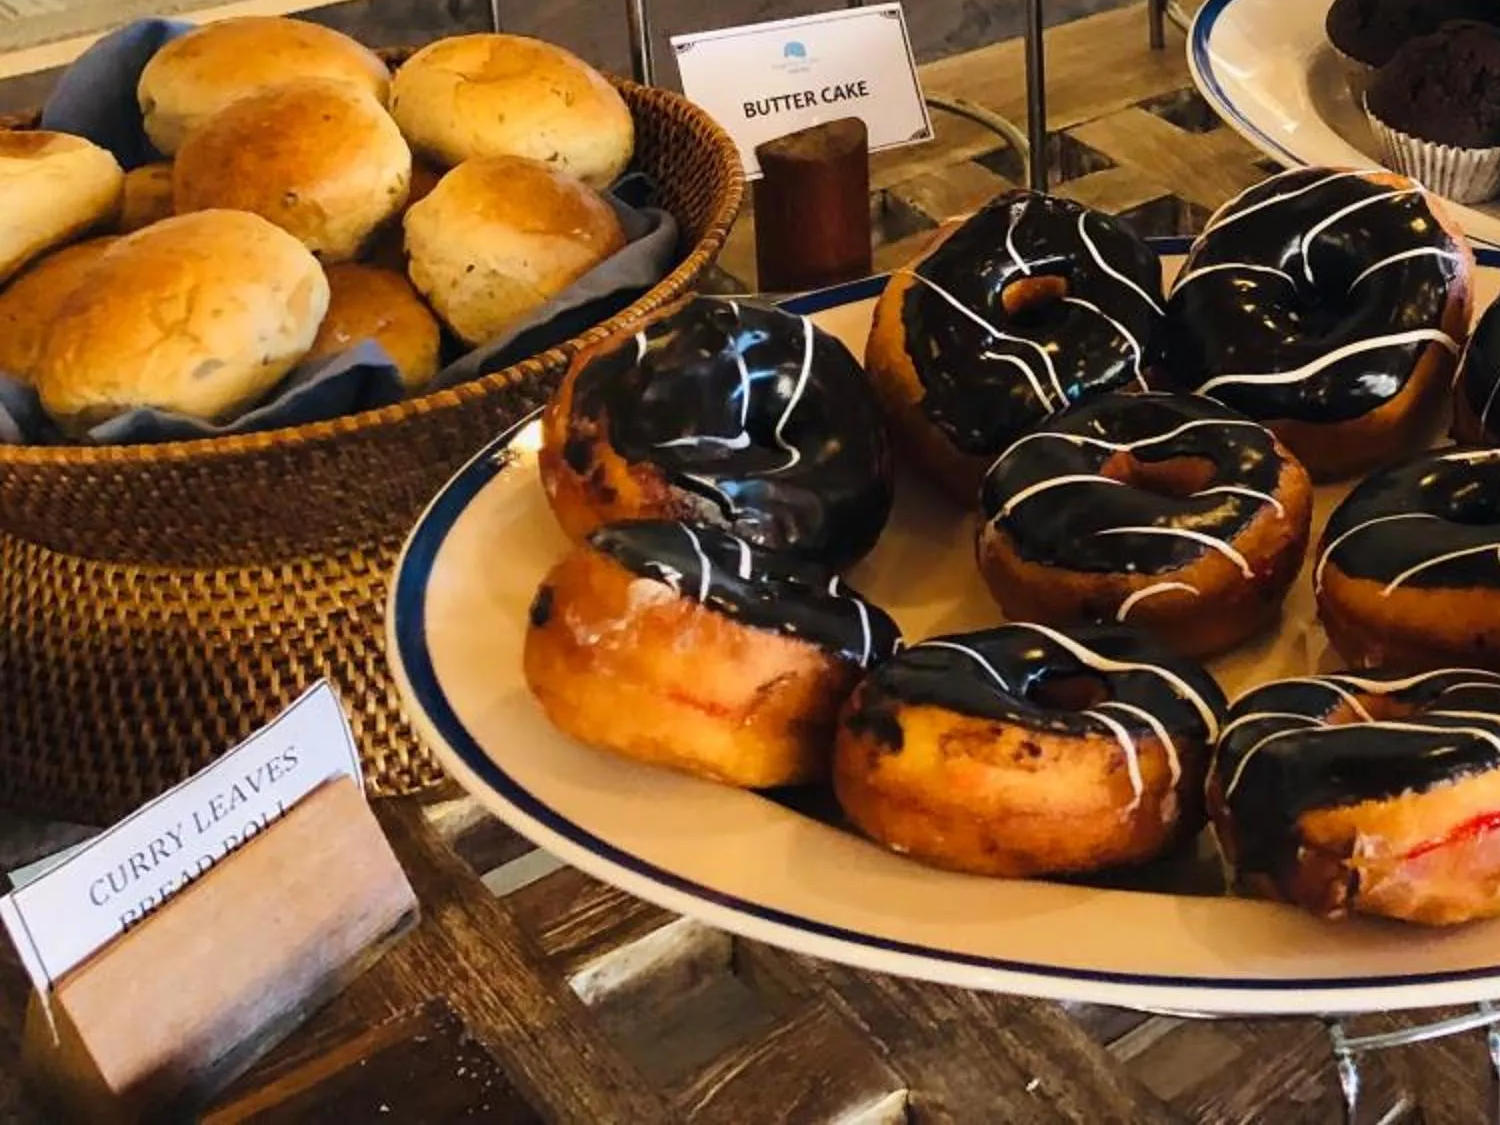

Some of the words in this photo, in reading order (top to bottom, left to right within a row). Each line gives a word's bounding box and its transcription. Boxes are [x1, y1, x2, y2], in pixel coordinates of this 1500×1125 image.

[743, 89, 817, 119] BUTTER
[821, 79, 870, 105] CAKE
[88, 821, 185, 908] CURRY
[192, 746, 300, 835] LEAVES
